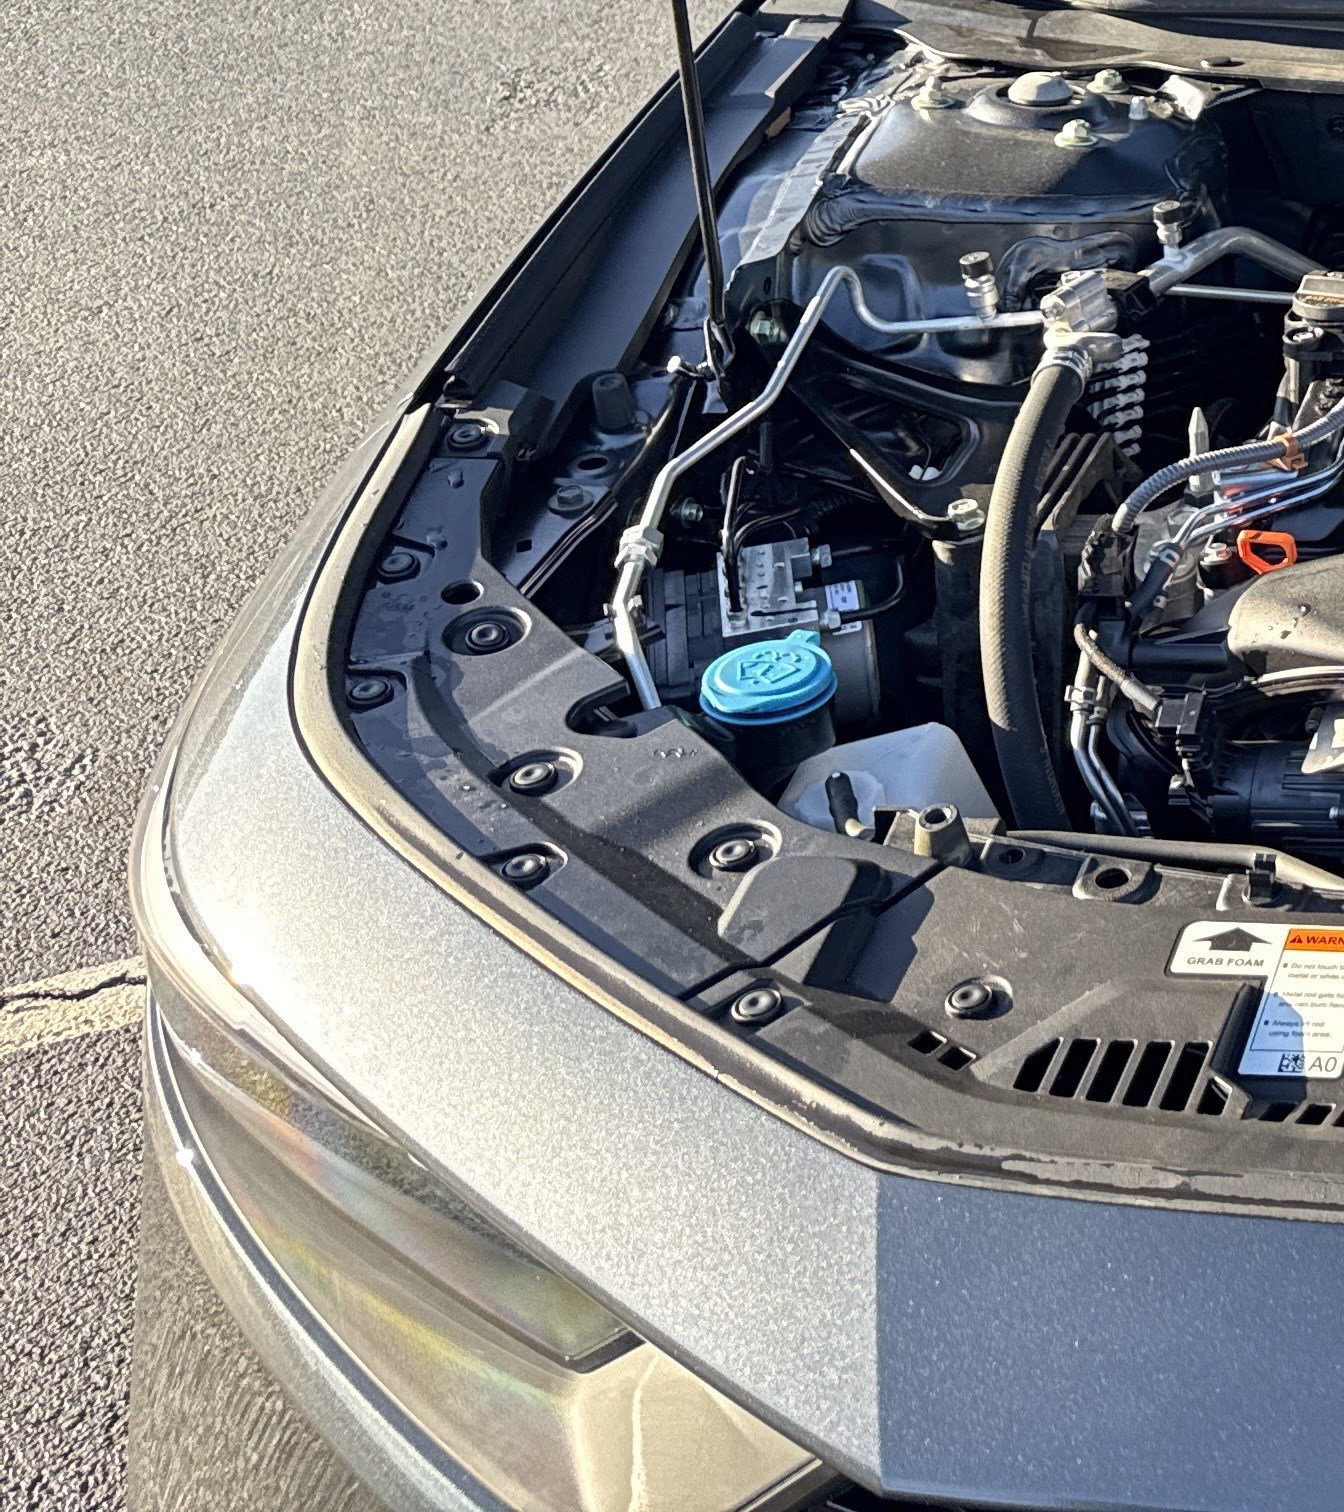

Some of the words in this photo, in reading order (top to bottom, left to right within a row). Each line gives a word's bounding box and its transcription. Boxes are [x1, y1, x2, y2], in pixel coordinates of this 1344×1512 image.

[1187, 957, 1224, 966] GRAB
[1227, 958, 1264, 967] FOAM
[1309, 1056, 1338, 1072] A0
